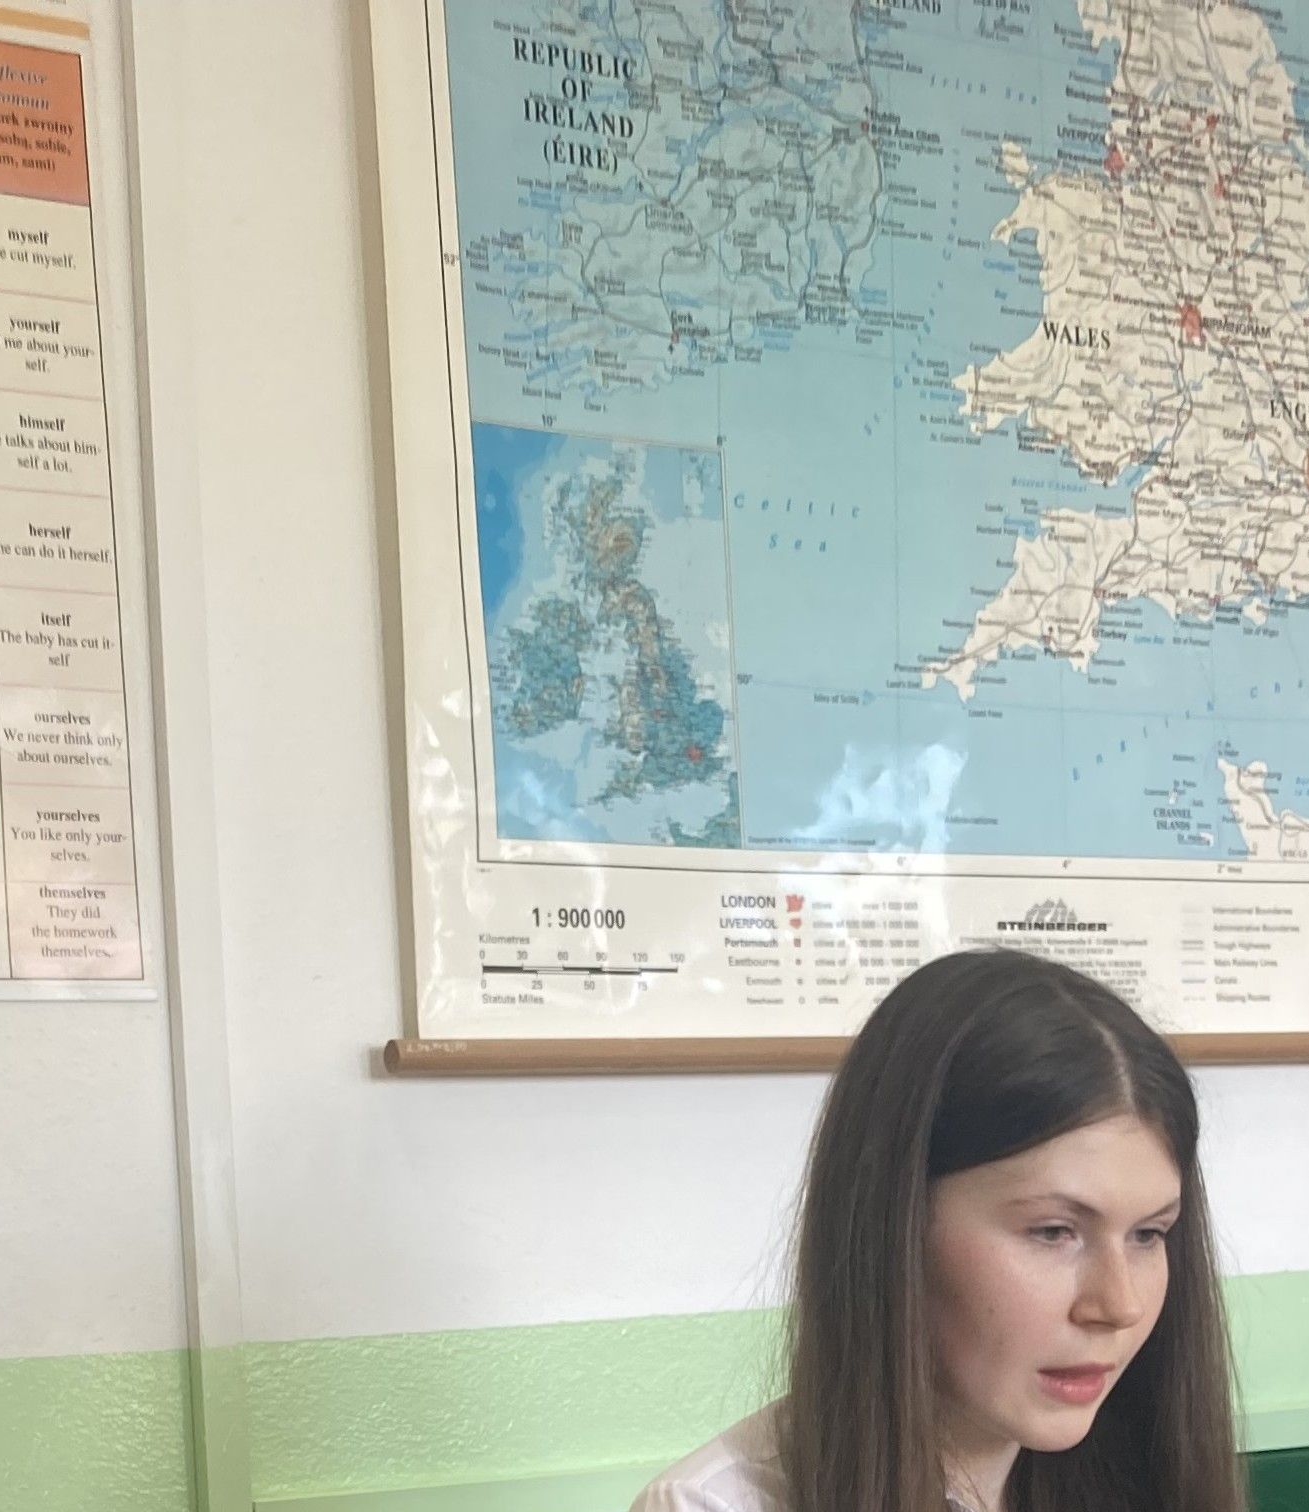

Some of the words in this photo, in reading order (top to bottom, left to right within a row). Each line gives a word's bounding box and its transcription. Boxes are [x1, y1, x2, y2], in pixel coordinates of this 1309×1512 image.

[512, 37, 637, 80] REPUBLIC
[561, 77, 593, 101] OF
[523, 98, 634, 139] IRELAND
[542, 135, 619, 175] (ÉIRE)
[8, 228, 50, 247] myself
[9, 317, 60, 336] yourself
[1042, 321, 1111, 351] WALES
[19, 414, 66, 432] himself
[734, 494, 860, 519] Celtic
[28, 522, 72, 540] herself
[14, 545, 35, 557] can
[39, 543, 54, 559] do
[58, 545, 66, 559] it
[769, 534, 827, 552] Sea
[41, 612, 72, 627] itself
[1100, 630, 1127, 641] Torbay
[34, 710, 91, 725] ourselves
[36, 808, 100, 825] yourselves
[1153, 808, 1192, 819] CHANNEL
[1156, 820, 1191, 831] ISLANDS
[50, 848, 90, 862] selves.
[39, 884, 106, 900] themselves
[720, 895, 776, 909] LONDON
[46, 904, 78, 922] They
[81, 905, 100, 919] did
[719, 917, 779, 930] LIVERPOOL
[996, 921, 1108, 932] STEINBERGER
[479, 934, 530, 945] Kilometres
[516, 951, 528, 960] 30
[728, 956, 780, 967] Eastbourne
[531, 980, 543, 990] 25
[584, 981, 595, 990] 50
[482, 994, 516, 1004] Statute
[518, 994, 544, 1005] Miles
